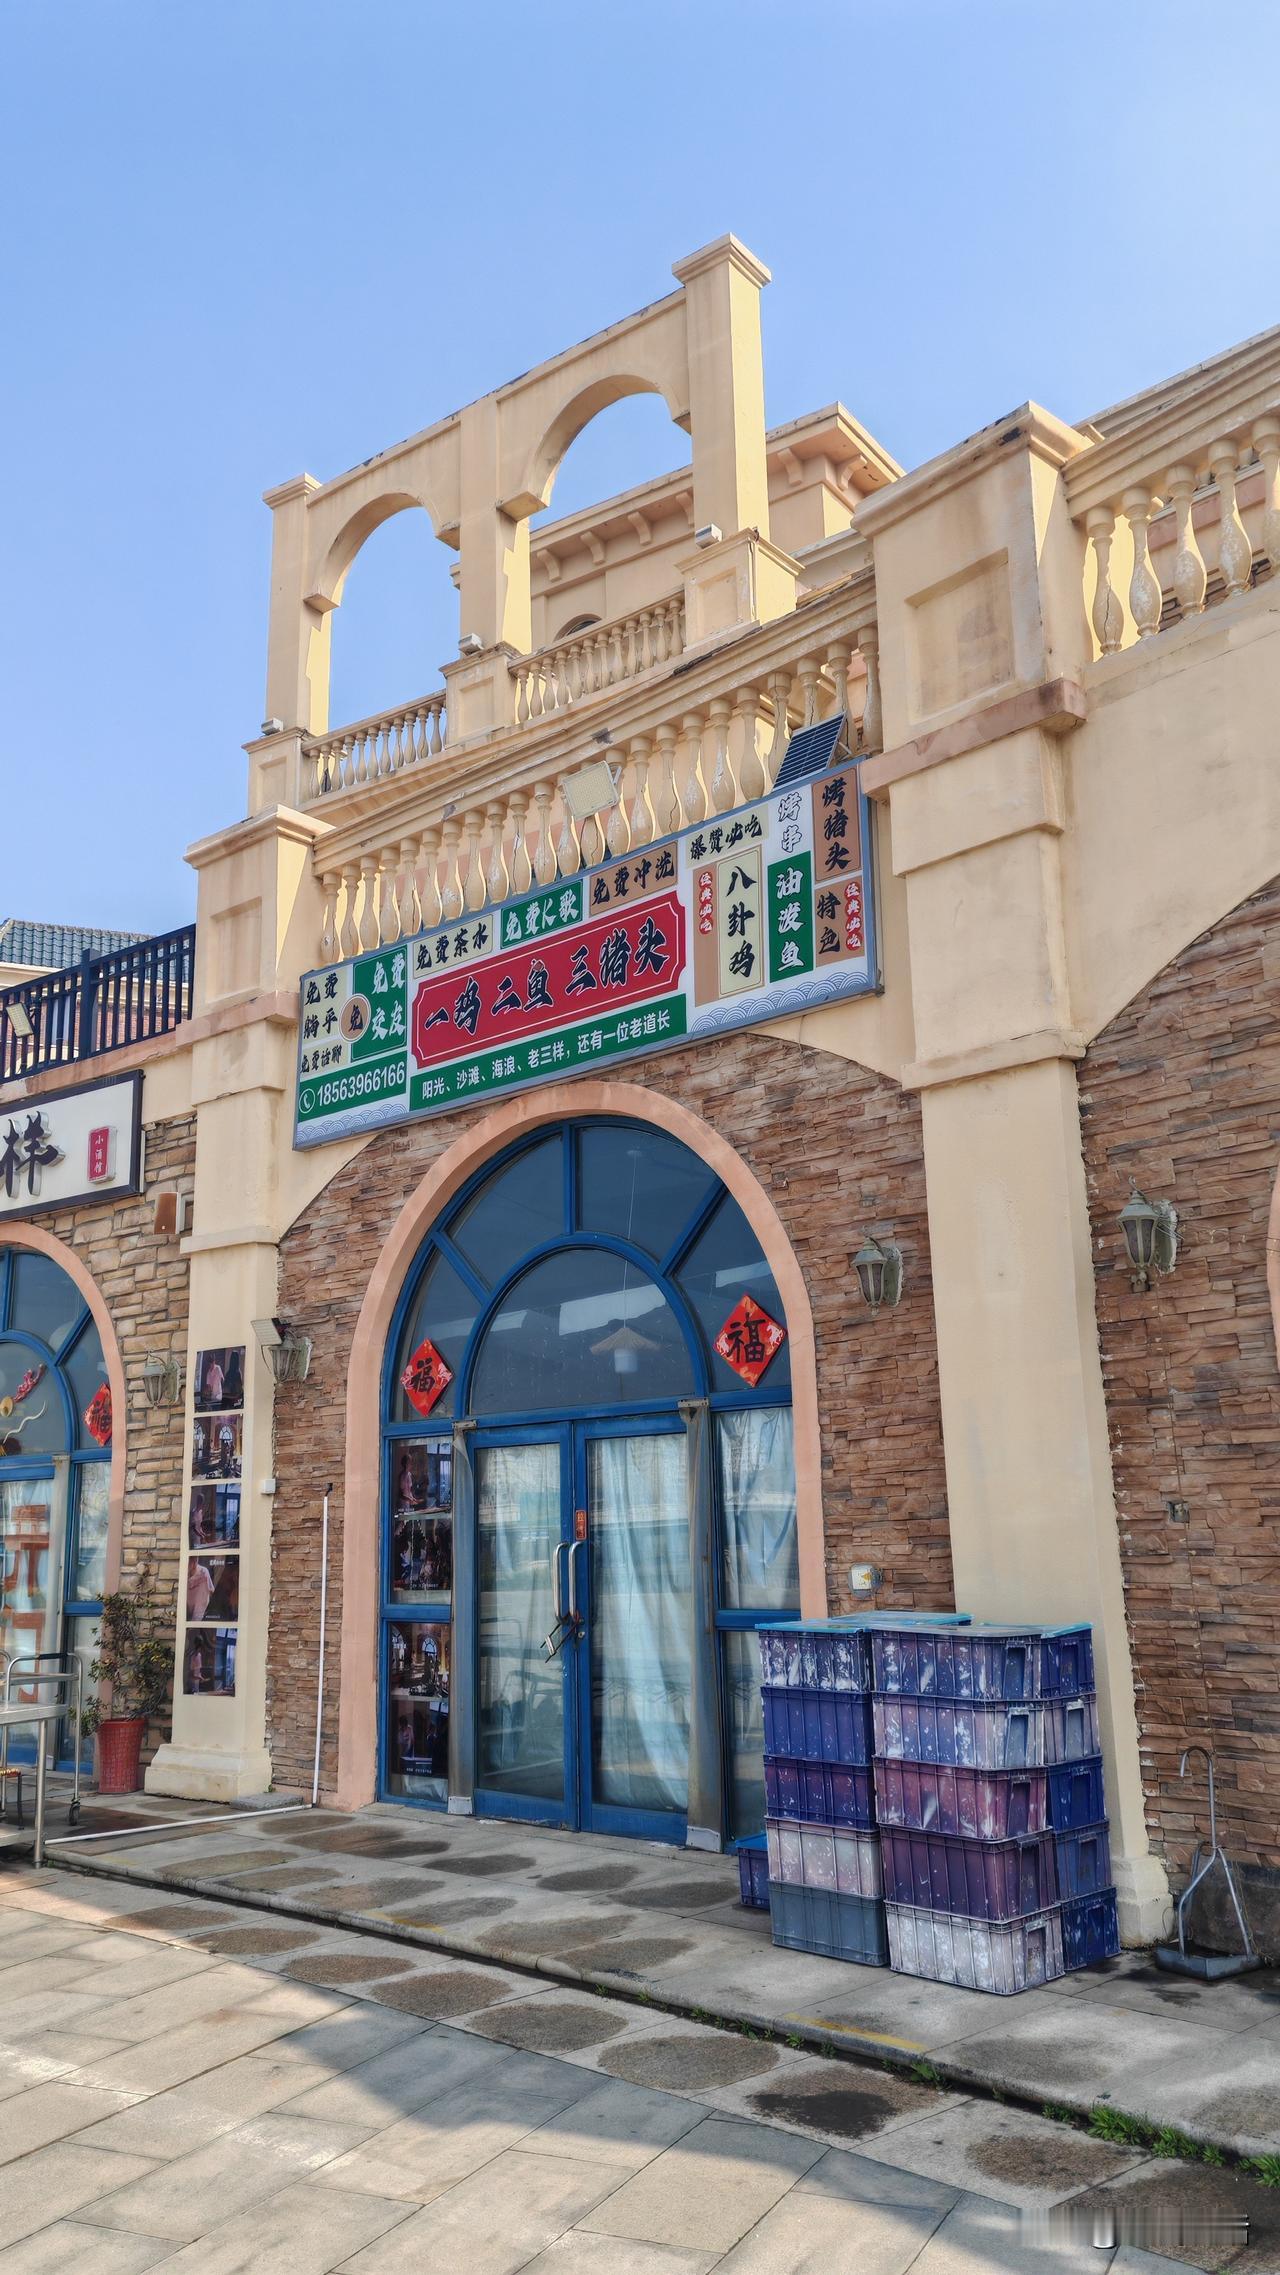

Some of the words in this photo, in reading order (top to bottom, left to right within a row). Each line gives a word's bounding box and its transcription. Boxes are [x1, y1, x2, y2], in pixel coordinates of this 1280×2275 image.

[778, 791, 803, 853] 烤串
[822, 777, 851, 872] 烤猪头
[592, 851, 675, 905] 免费冲洗
[699, 872, 713, 932] 经典必吃
[504, 889, 579, 942] 免费K歌
[726, 866, 757, 978] 八卦鸡
[816, 891, 841, 955] 特色
[846, 883, 862, 949] 经典必吃
[415, 922, 490, 971] 免费茶水
[305, 972, 339, 1006] 免费
[371, 952, 406, 995] 免费
[371, 1000, 407, 1041] 交友
[317, 1061, 405, 1107] 18563966166
[727, 1312, 766, 1364] 福
[411, 1356, 436, 1394] 福
